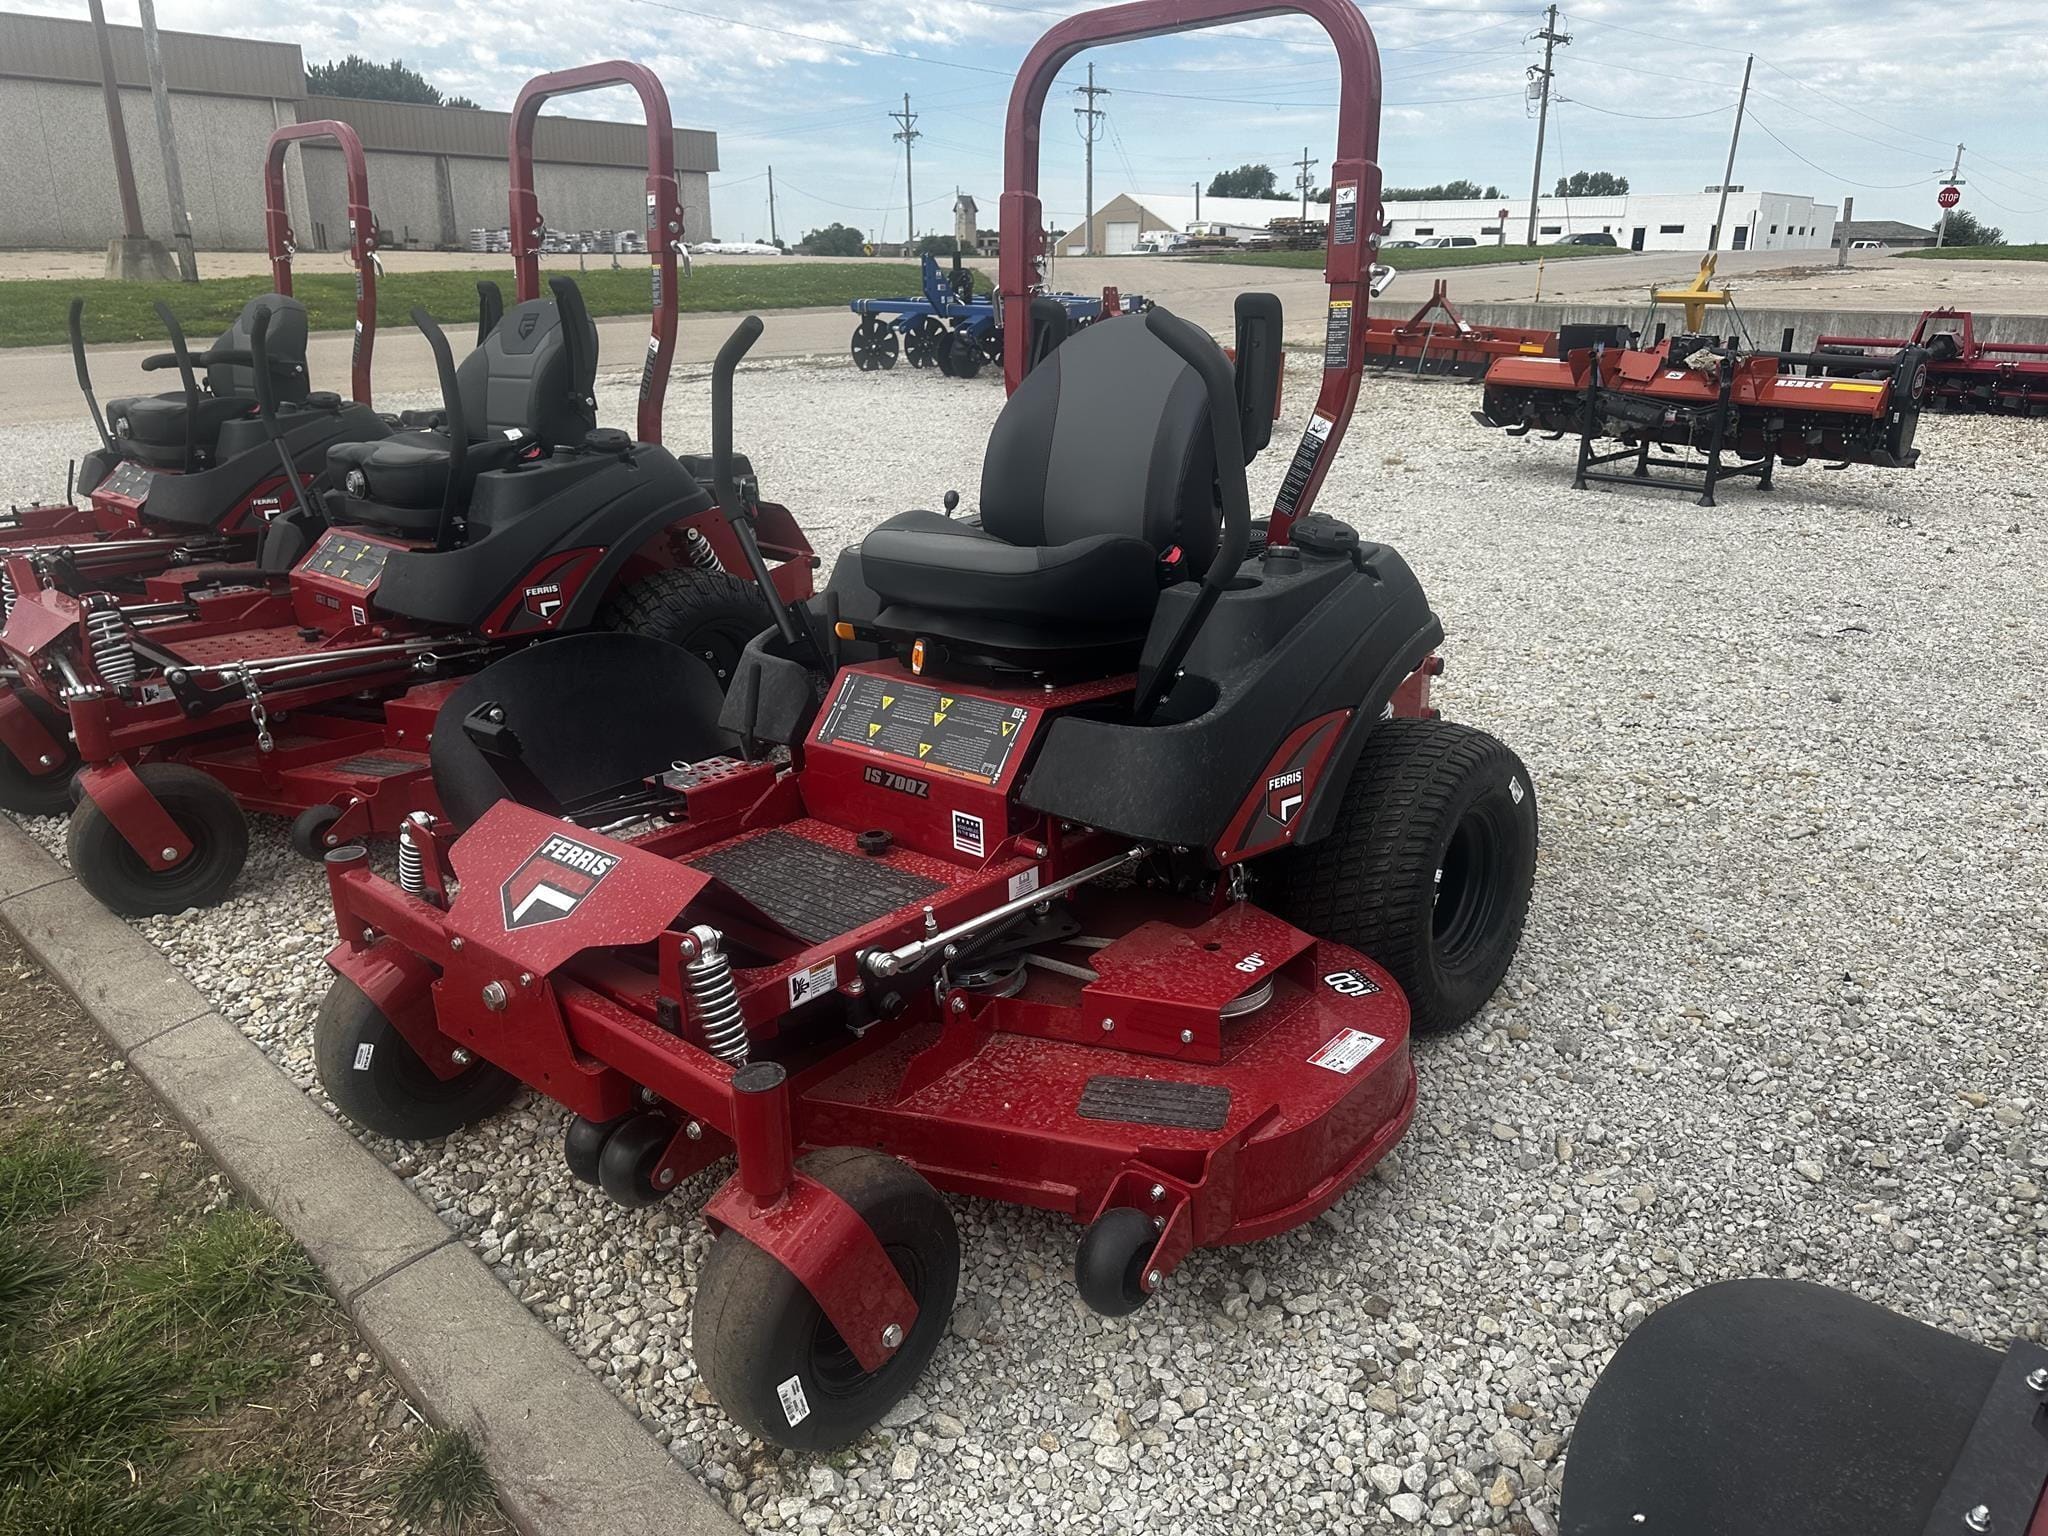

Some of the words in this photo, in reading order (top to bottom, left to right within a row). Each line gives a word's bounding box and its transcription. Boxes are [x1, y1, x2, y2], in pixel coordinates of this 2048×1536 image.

[1940, 193, 1959, 202] STOP
[253, 498, 279, 506] FERRIS
[526, 585, 558, 597] FERRIS
[864, 767, 882, 784] IS
[884, 772, 929, 797] 700Z
[1268, 771, 1302, 791] FERRIS
[969, 832, 980, 840] USA
[541, 838, 612, 876] FERRIS
